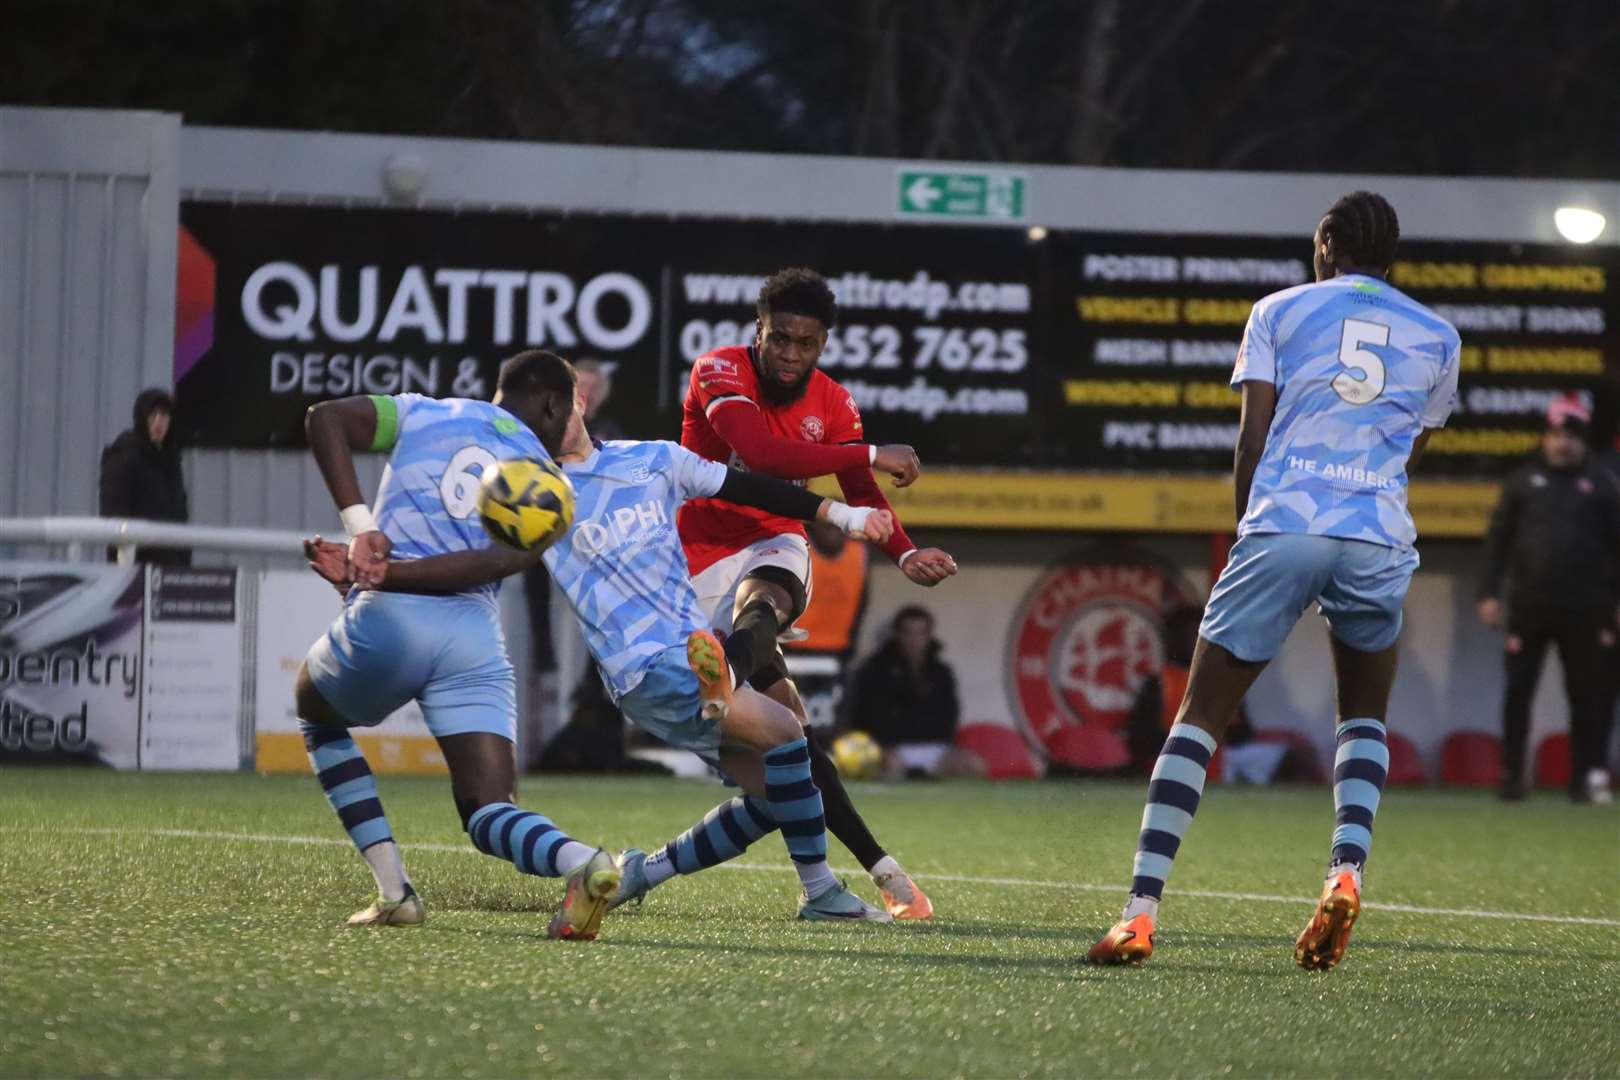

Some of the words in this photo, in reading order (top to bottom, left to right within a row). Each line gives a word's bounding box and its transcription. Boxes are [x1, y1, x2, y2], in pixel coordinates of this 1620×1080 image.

[1083, 254, 1180, 280] POSTER
[1182, 257, 1308, 284] PRINTING
[1482, 263, 1606, 292] GRAPHICS
[240, 260, 652, 350] QUATTRO
[1077, 297, 1180, 322] VEHICLE
[912, 327, 1028, 372] 7625
[1095, 338, 1168, 365] MESH
[1170, 339, 1240, 366] BANN
[1329, 317, 1391, 406] 5
[1486, 346, 1604, 373] BANNERS
[269, 351, 439, 396] DESIGN
[451, 355, 486, 397] &
[1064, 380, 1180, 406] WINDOW
[1102, 421, 1155, 448] PVC
[440, 445, 497, 520] 6
[1322, 463, 1400, 488] AMBERS
[614, 499, 668, 534] PHI
[1, 700, 88, 750] ted
